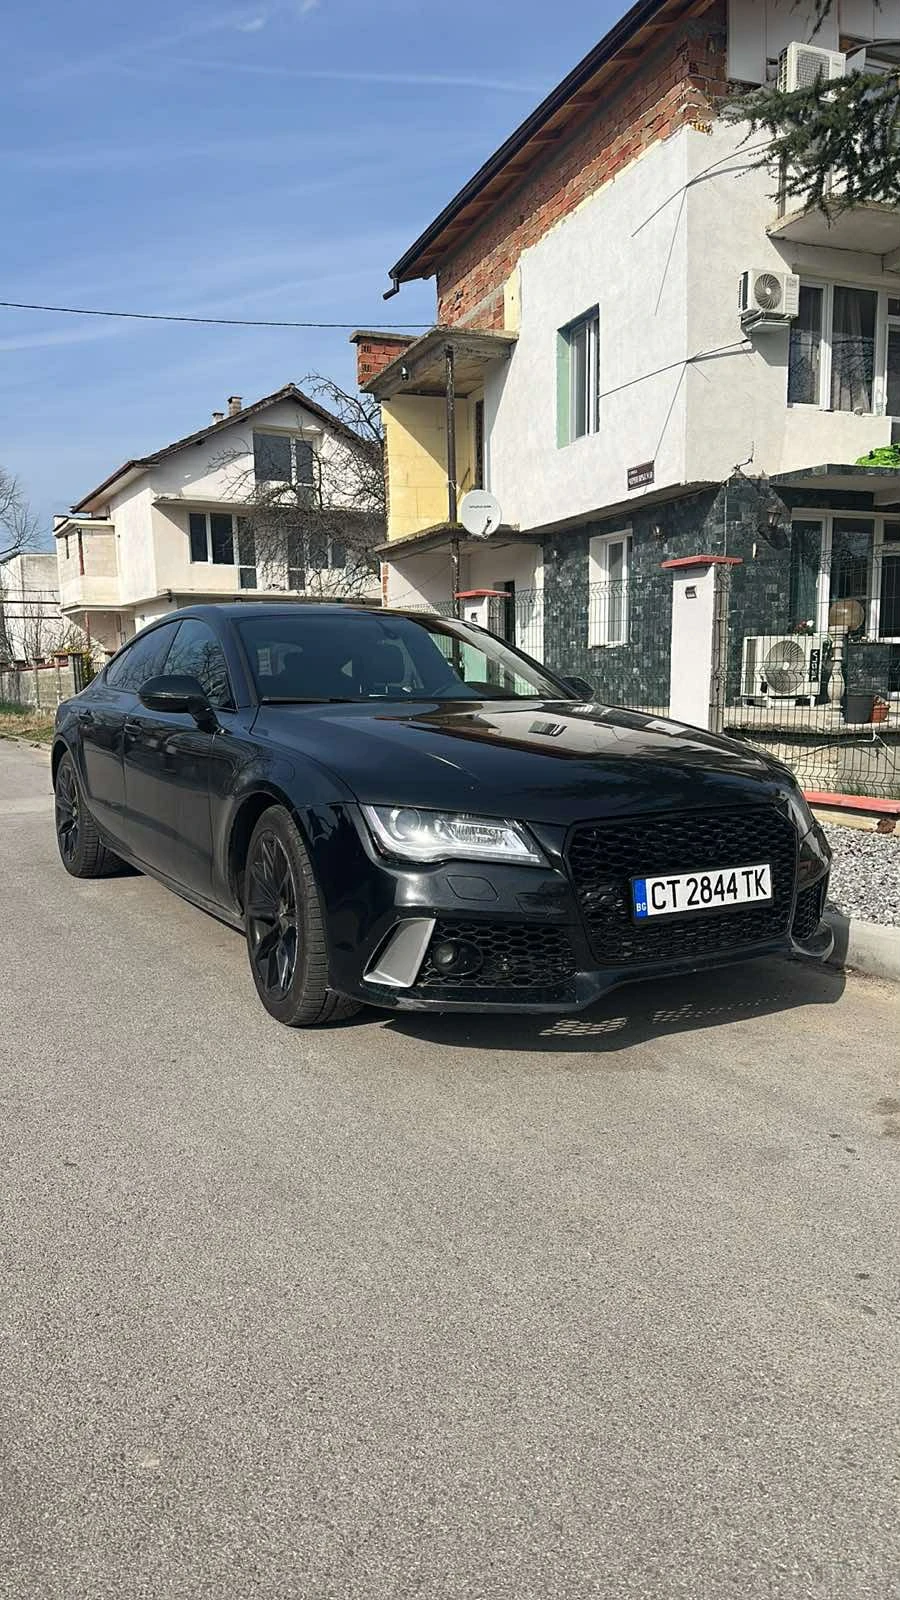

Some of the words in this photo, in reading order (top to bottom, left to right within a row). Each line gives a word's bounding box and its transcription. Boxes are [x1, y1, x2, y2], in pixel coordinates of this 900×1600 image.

[651, 880, 680, 910] CT
[686, 872, 738, 906] 2844
[742, 868, 767, 898] TK
[636, 902, 647, 912] BG
